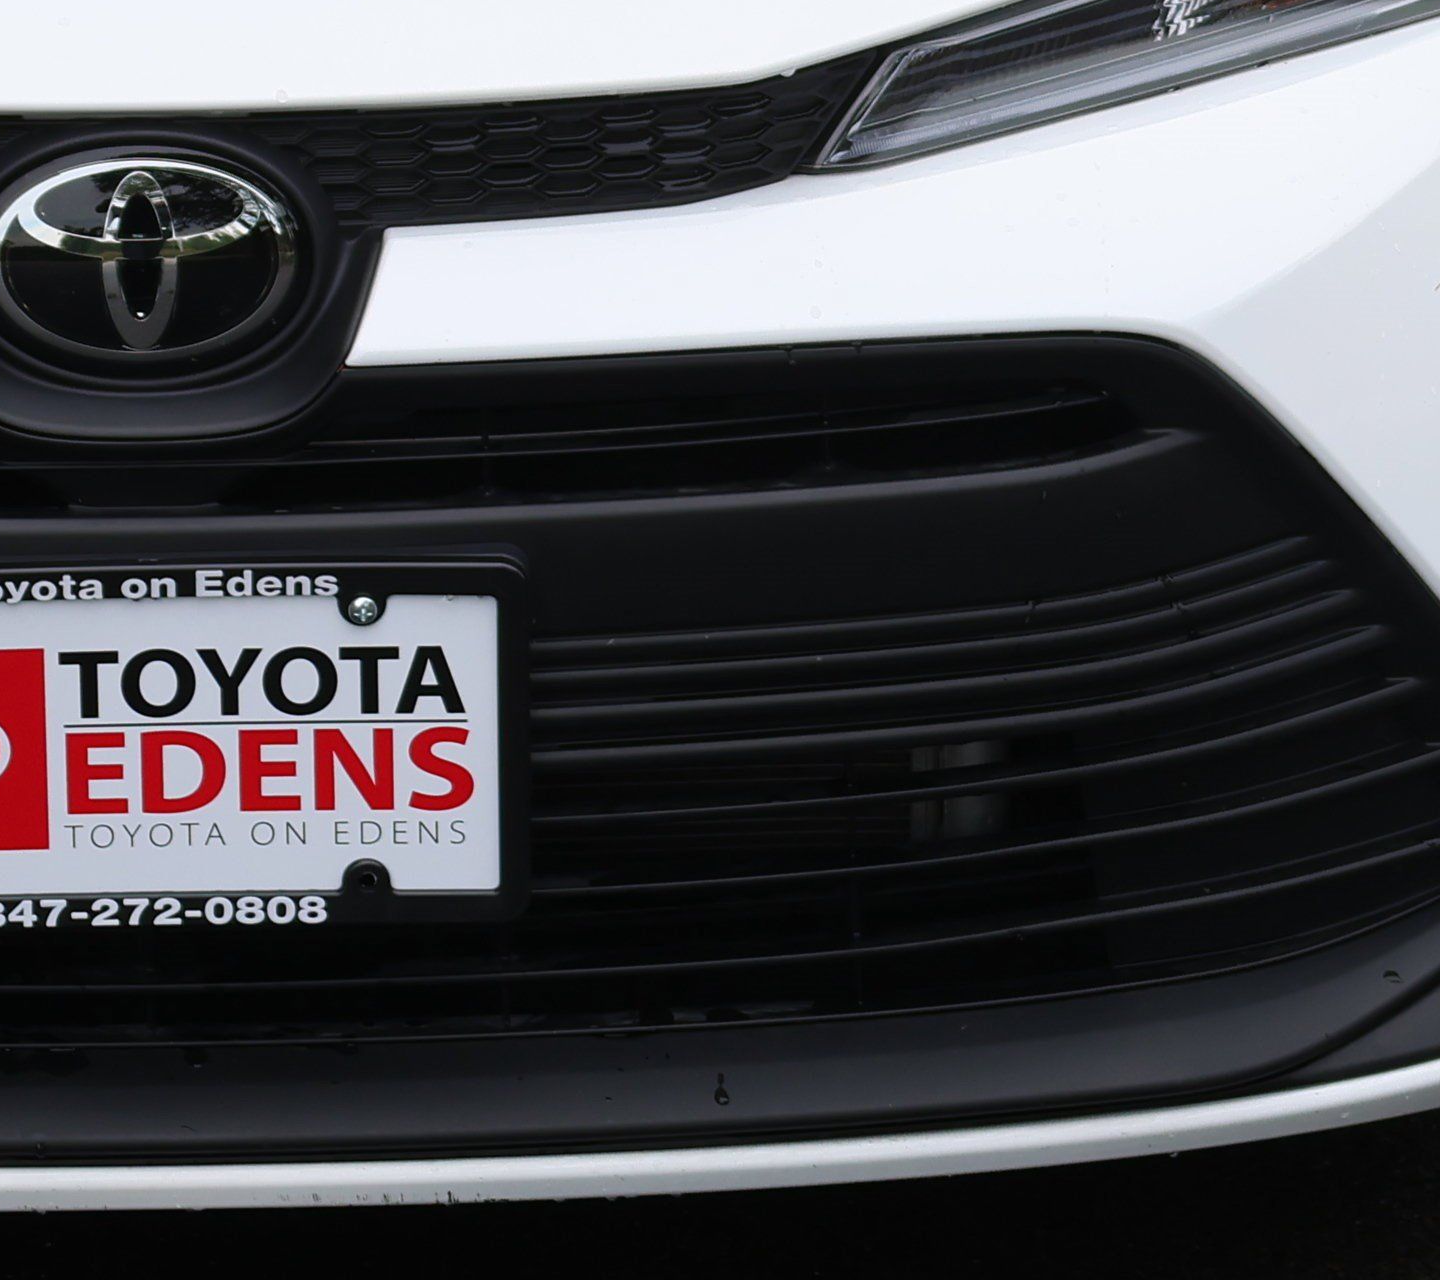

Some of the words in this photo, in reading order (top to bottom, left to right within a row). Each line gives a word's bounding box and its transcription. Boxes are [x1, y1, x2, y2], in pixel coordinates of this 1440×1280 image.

[121, 577, 177, 599] on
[195, 570, 339, 598] Edens
[59, 645, 467, 719] TOYOTA
[67, 727, 475, 814] EDENS
[63, 821, 225, 849] TOYOTA
[251, 821, 310, 847] ON
[335, 820, 467, 845] EDENS
